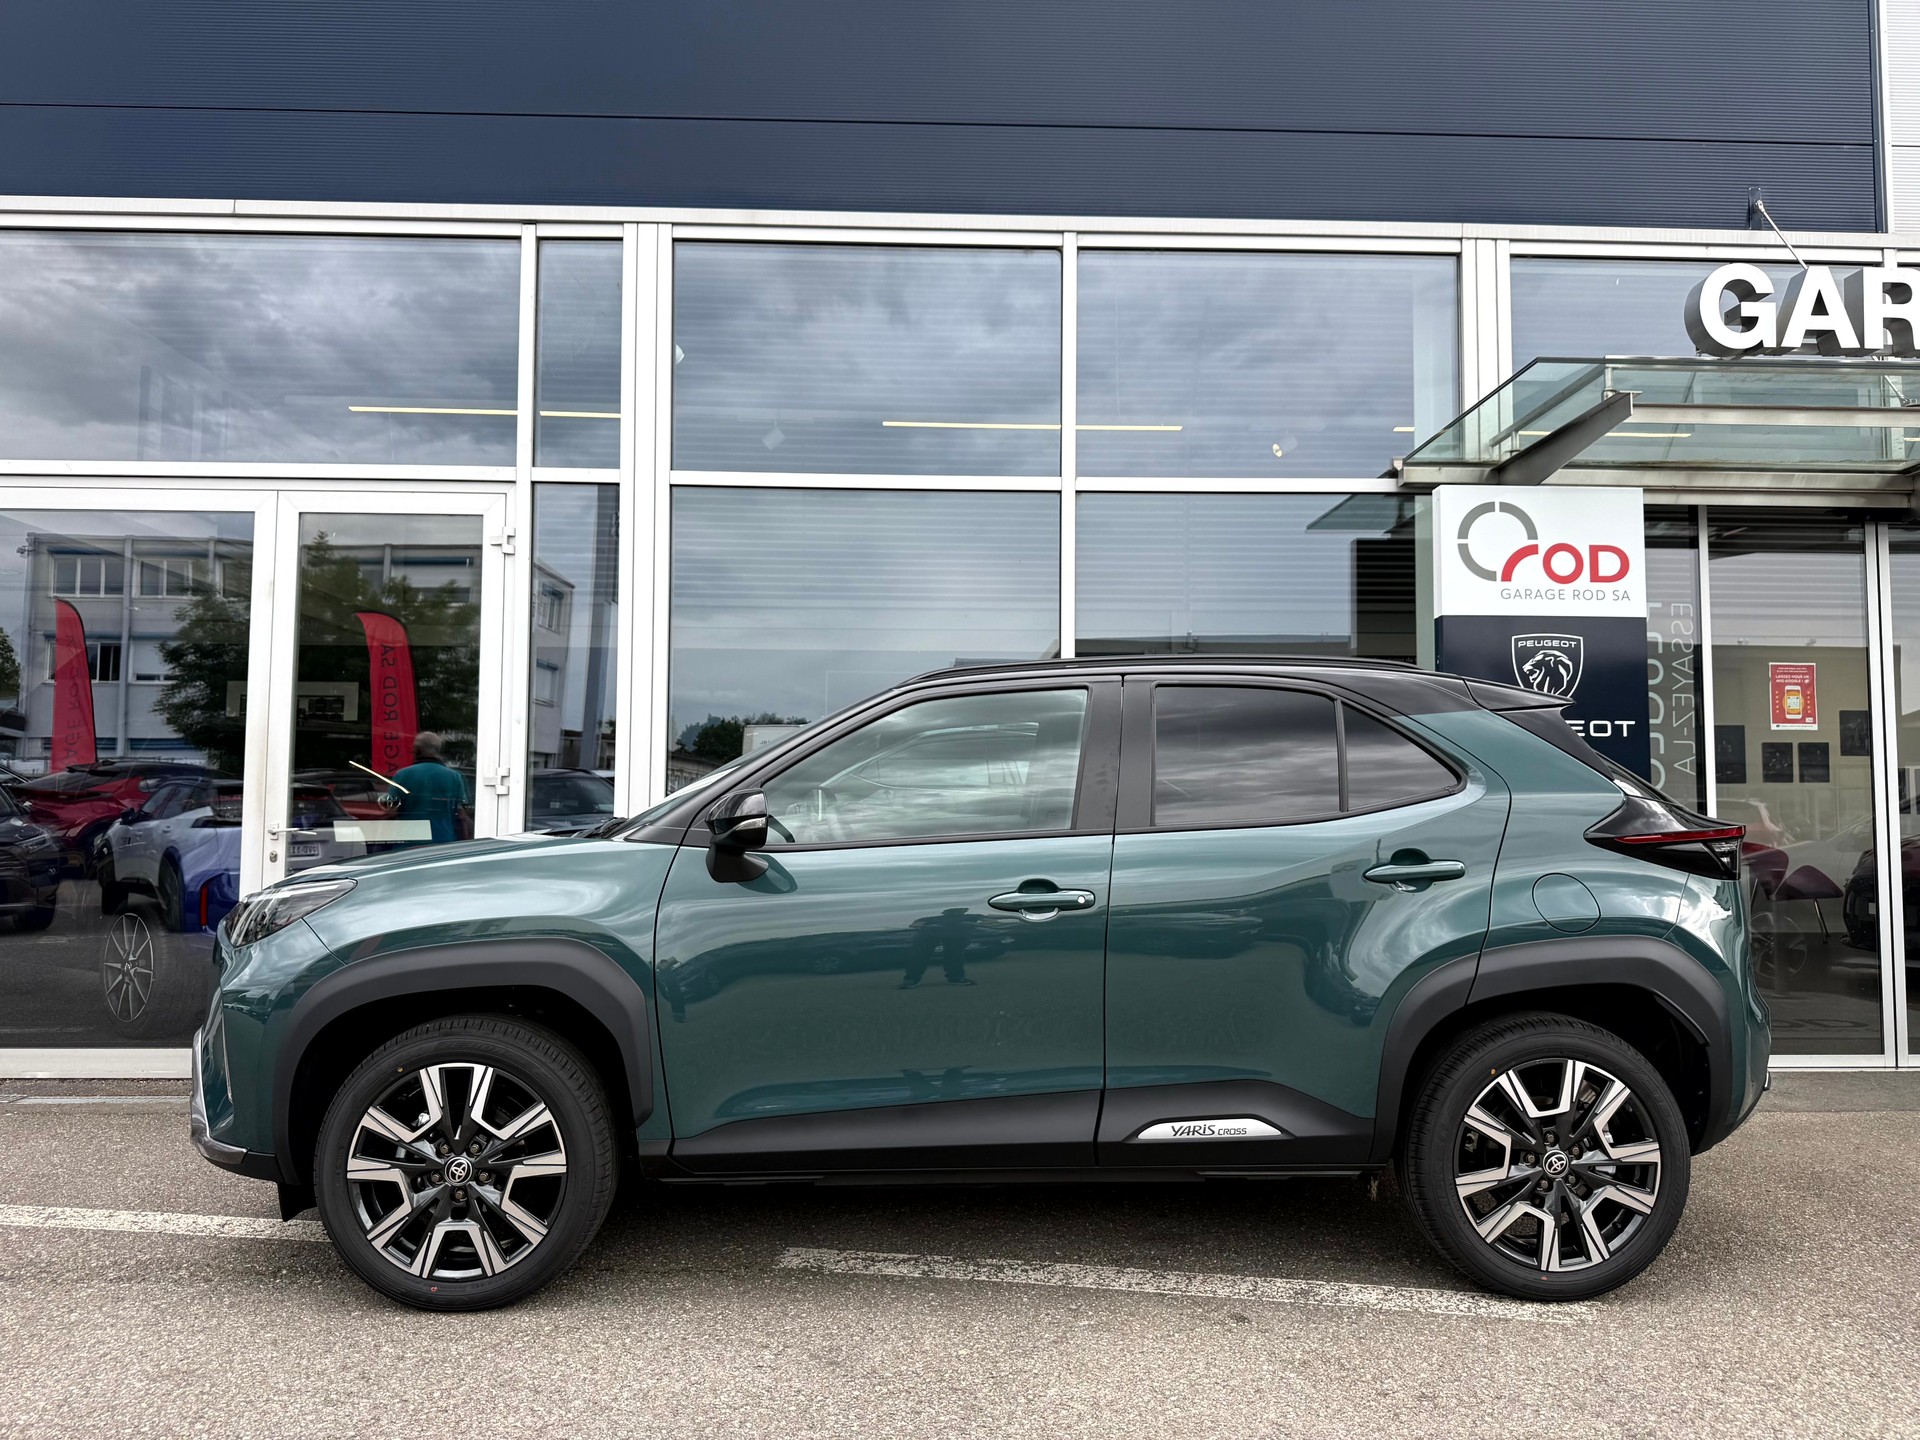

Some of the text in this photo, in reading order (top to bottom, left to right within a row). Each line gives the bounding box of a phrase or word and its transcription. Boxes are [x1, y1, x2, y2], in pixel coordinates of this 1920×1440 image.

[1698, 262, 1920, 350] GAR
[1500, 588, 1631, 601] GARAGE ROD SA
[1517, 639, 1578, 648] PEUGEOT
[1564, 720, 1636, 737] EOT
[1217, 1127, 1248, 1136] CROSS
